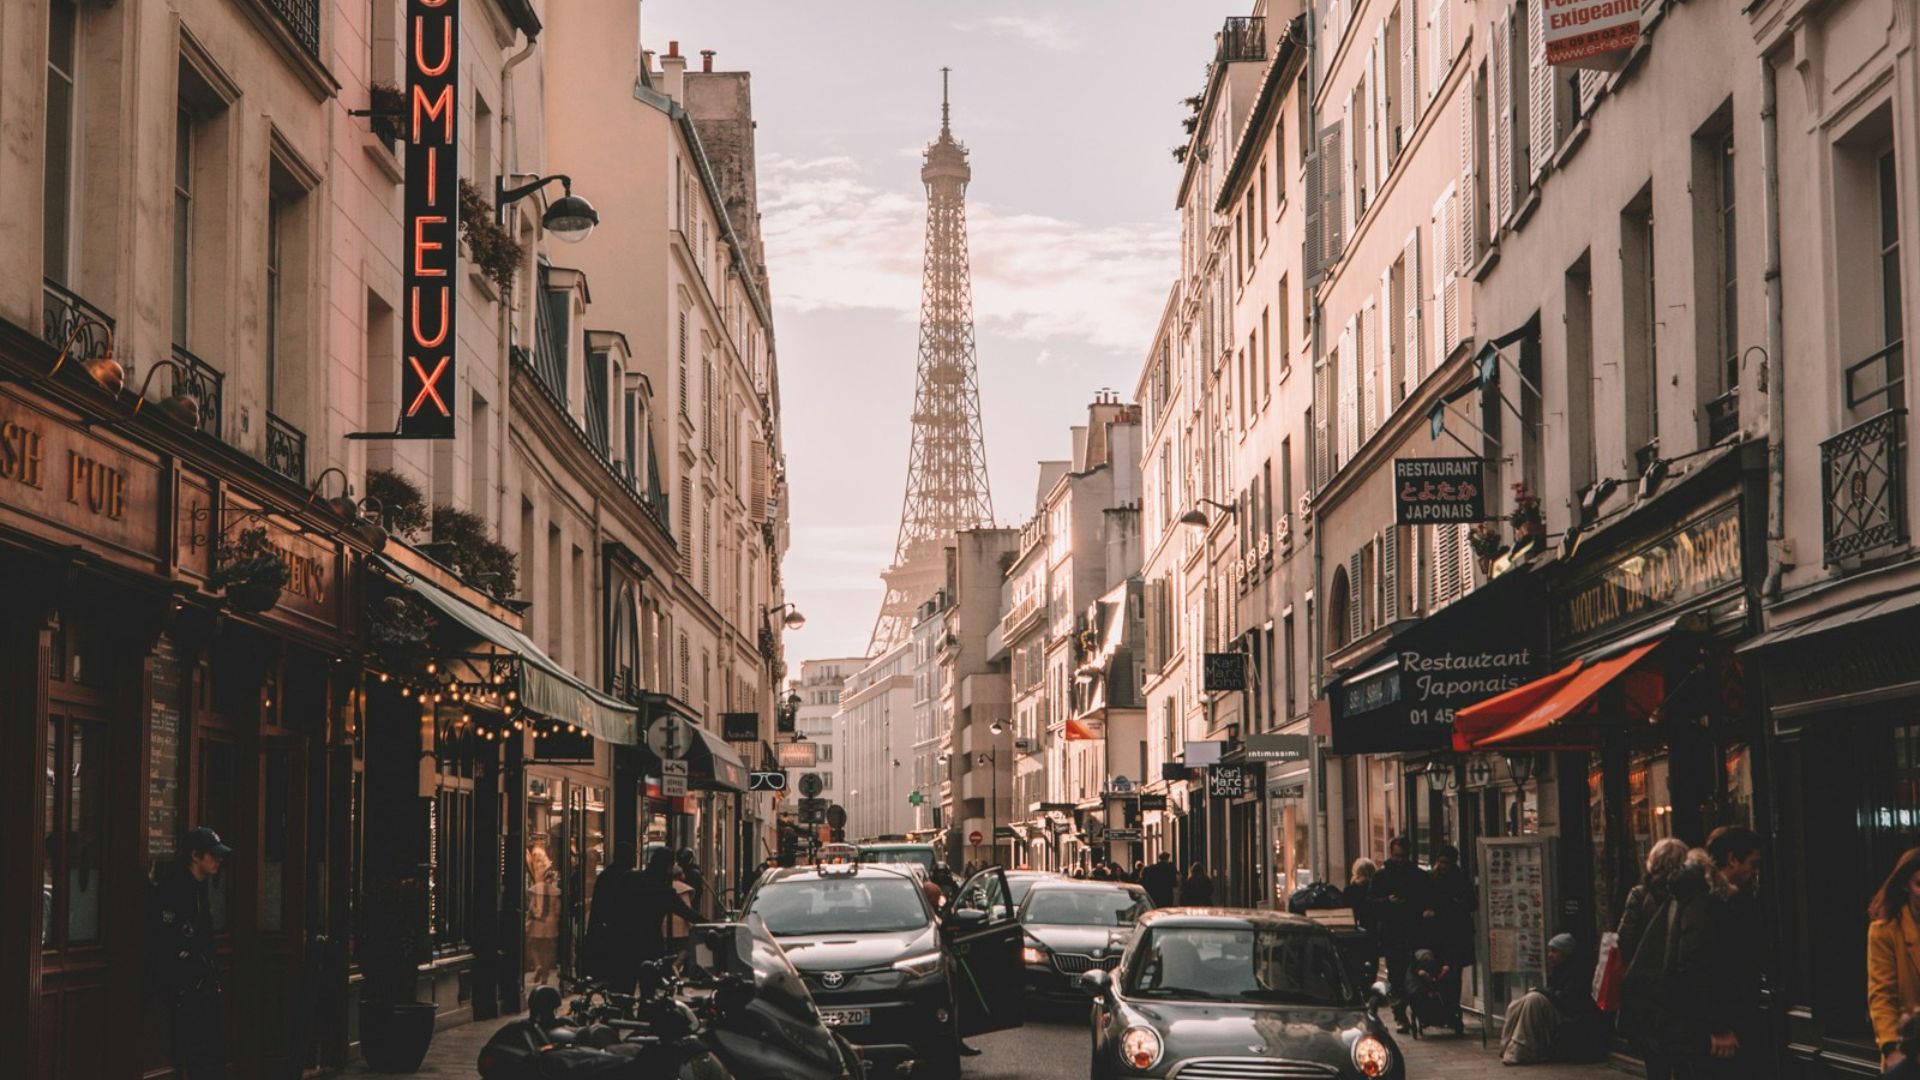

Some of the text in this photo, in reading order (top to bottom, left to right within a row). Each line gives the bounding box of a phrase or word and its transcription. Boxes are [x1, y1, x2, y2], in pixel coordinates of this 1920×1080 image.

[406, 0, 454, 417] UMIEUX
[1397, 461, 1479, 477] RESTAURANT
[1401, 480, 1477, 502] とよたか
[1405, 504, 1474, 519] JAPONAIS
[1570, 577, 1620, 633] MOULIN
[1625, 564, 1645, 613] DE
[1651, 552, 1674, 600] LA
[1677, 516, 1742, 590] VIERGE
[1212, 657, 1242, 668] Karl
[1401, 648, 1531, 672] Restaurant
[1206, 667, 1242, 678] Marc
[1206, 677, 1242, 688] John
[1416, 674, 1520, 702] Japonais
[1410, 708, 1454, 725] 01 45
[1248, 750, 1299, 758] intimissimi
[1216, 767, 1242, 778] Karl
[1211, 776, 1242, 787] Marc
[1211, 786, 1242, 796] John
